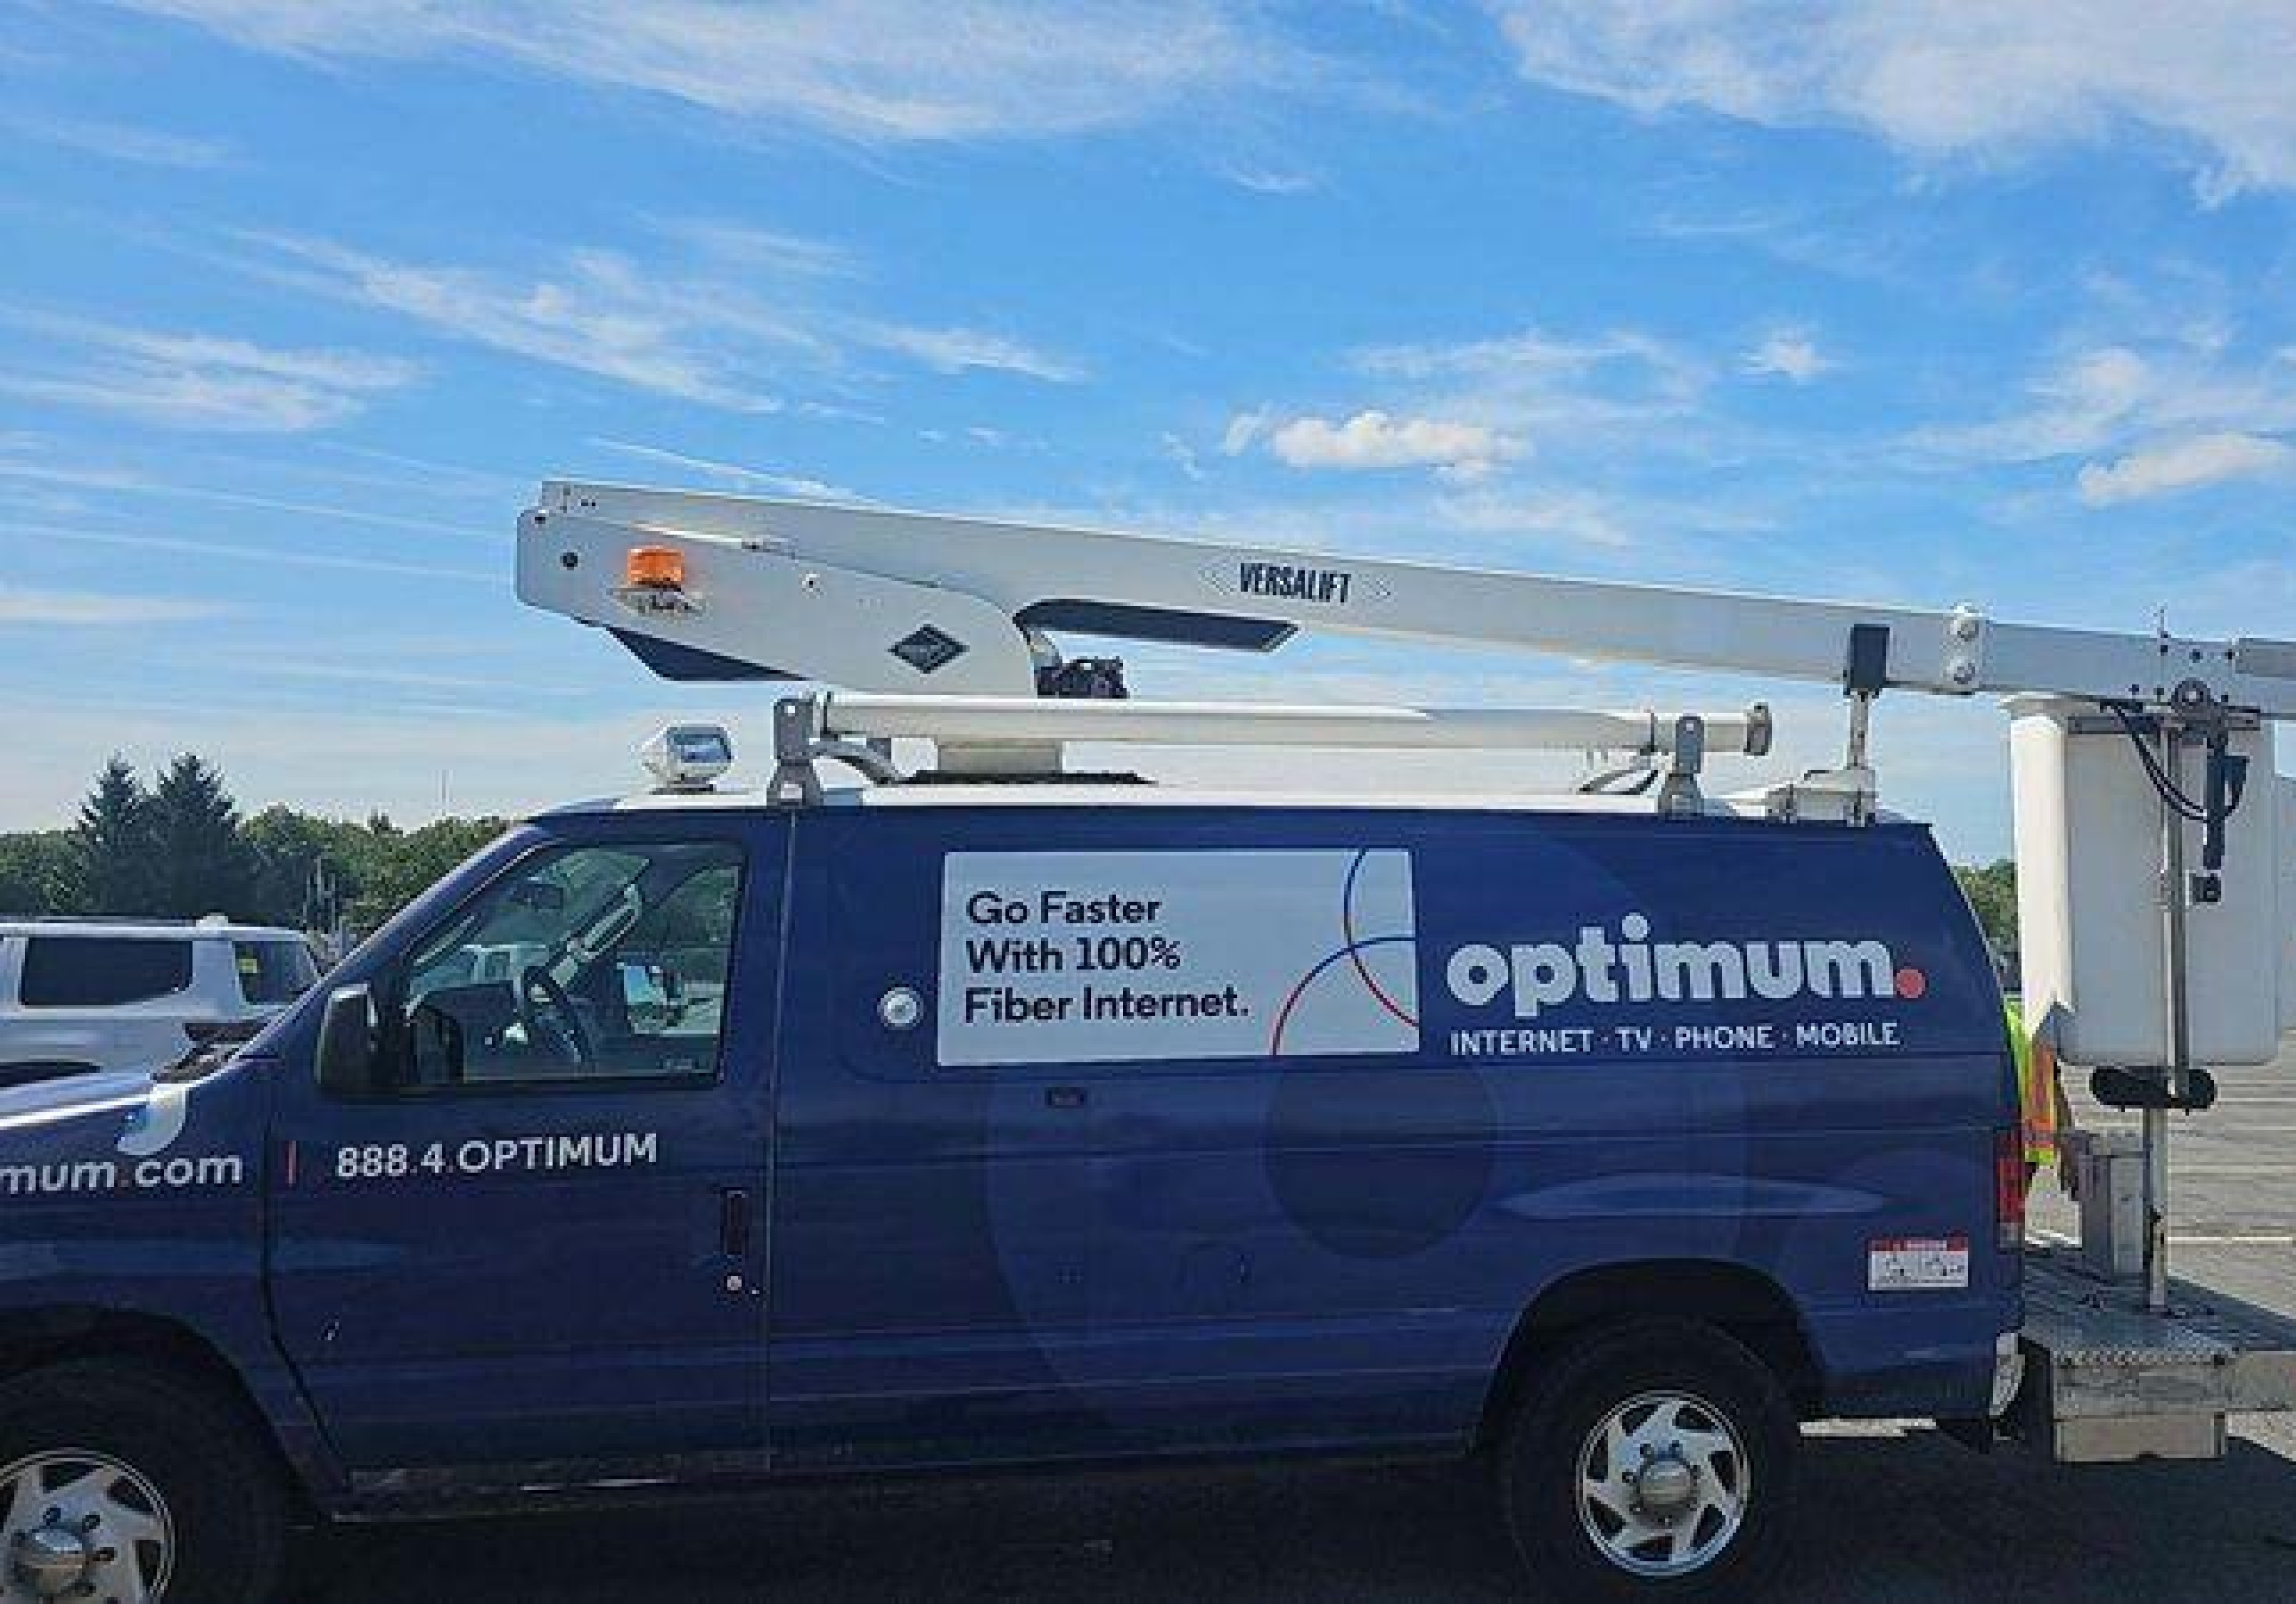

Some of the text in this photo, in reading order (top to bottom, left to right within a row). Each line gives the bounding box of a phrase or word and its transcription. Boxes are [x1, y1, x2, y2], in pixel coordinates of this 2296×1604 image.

[1240, 562, 1352, 603] VERSALIFT
[967, 890, 1162, 924] Go Faster
[965, 937, 1182, 973] With 100%
[964, 986, 1250, 1024] Fiber Internet.
[1451, 1022, 1901, 1055] INTERNET TV PHONE MOBILE
